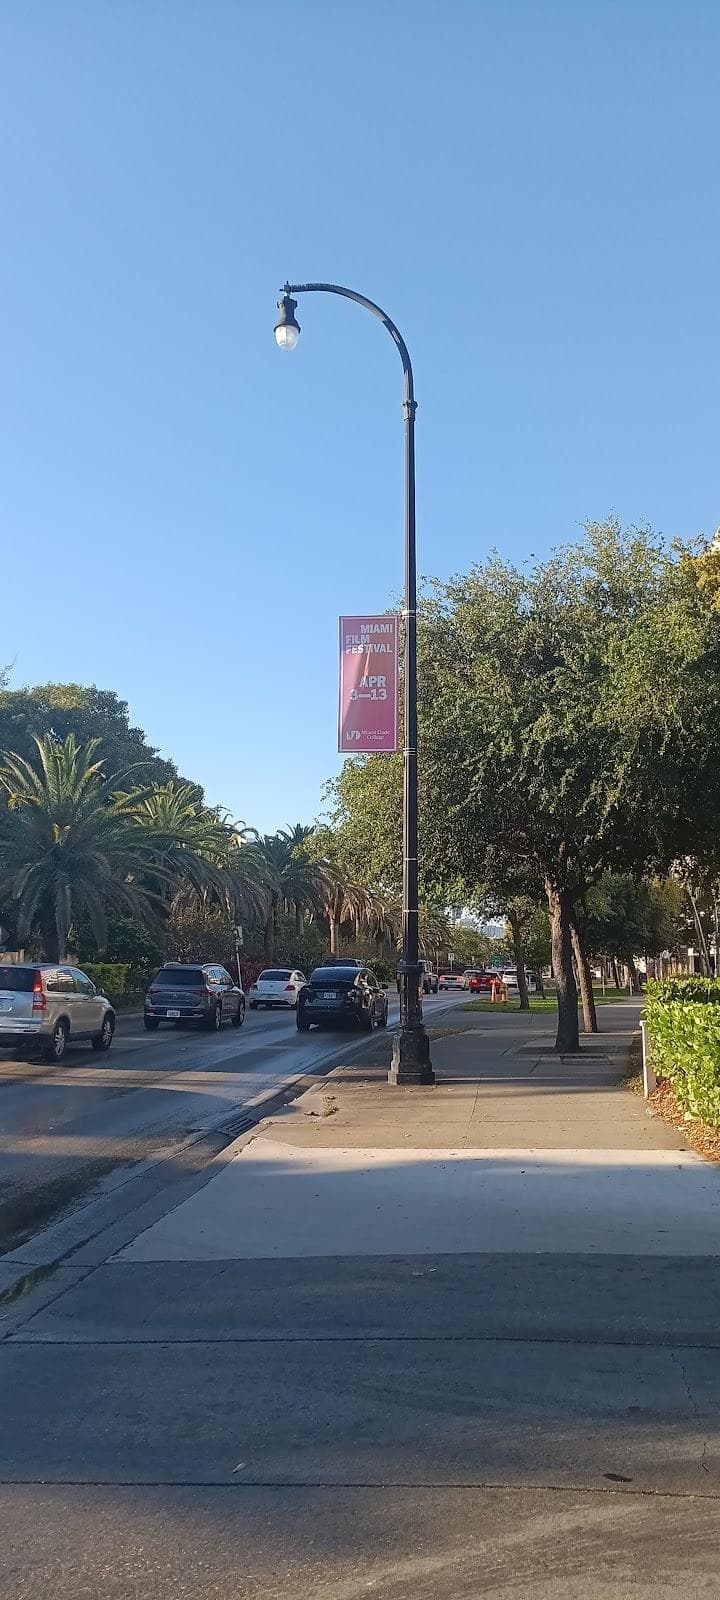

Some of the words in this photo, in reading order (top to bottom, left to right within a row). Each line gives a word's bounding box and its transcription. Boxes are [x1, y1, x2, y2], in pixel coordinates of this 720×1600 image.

[360, 624, 393, 634] MIAMI
[345, 635, 370, 644] FILM
[345, 644, 393, 654] FESTIVAL
[359, 676, 386, 687] APR
